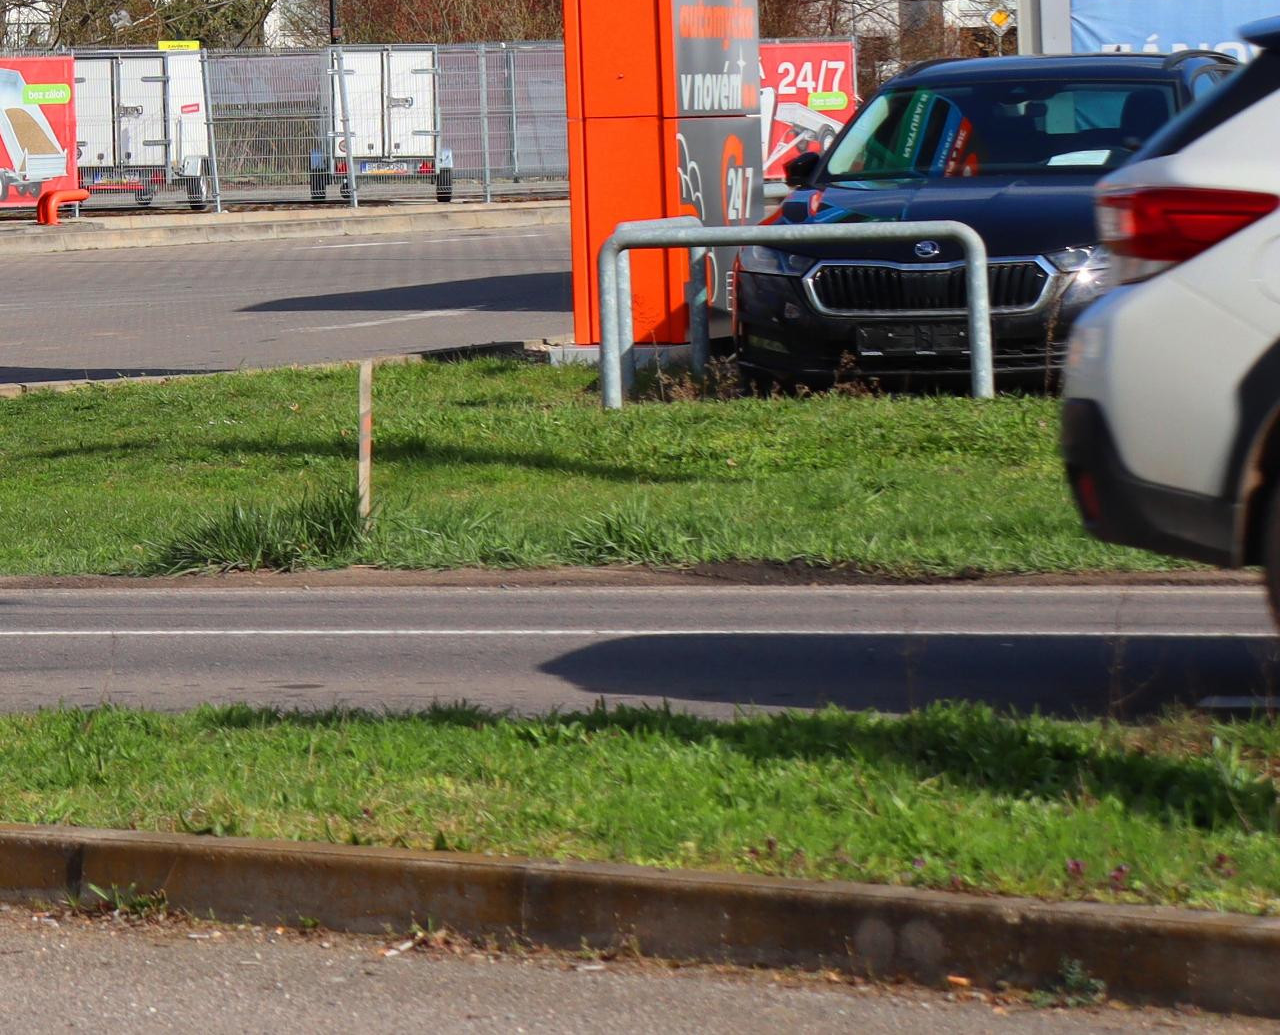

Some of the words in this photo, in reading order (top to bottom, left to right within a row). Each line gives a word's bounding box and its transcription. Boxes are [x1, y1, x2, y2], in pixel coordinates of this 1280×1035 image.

[680, 73, 693, 111] v
[694, 61, 742, 112] novém
[777, 59, 846, 95] 24/7
